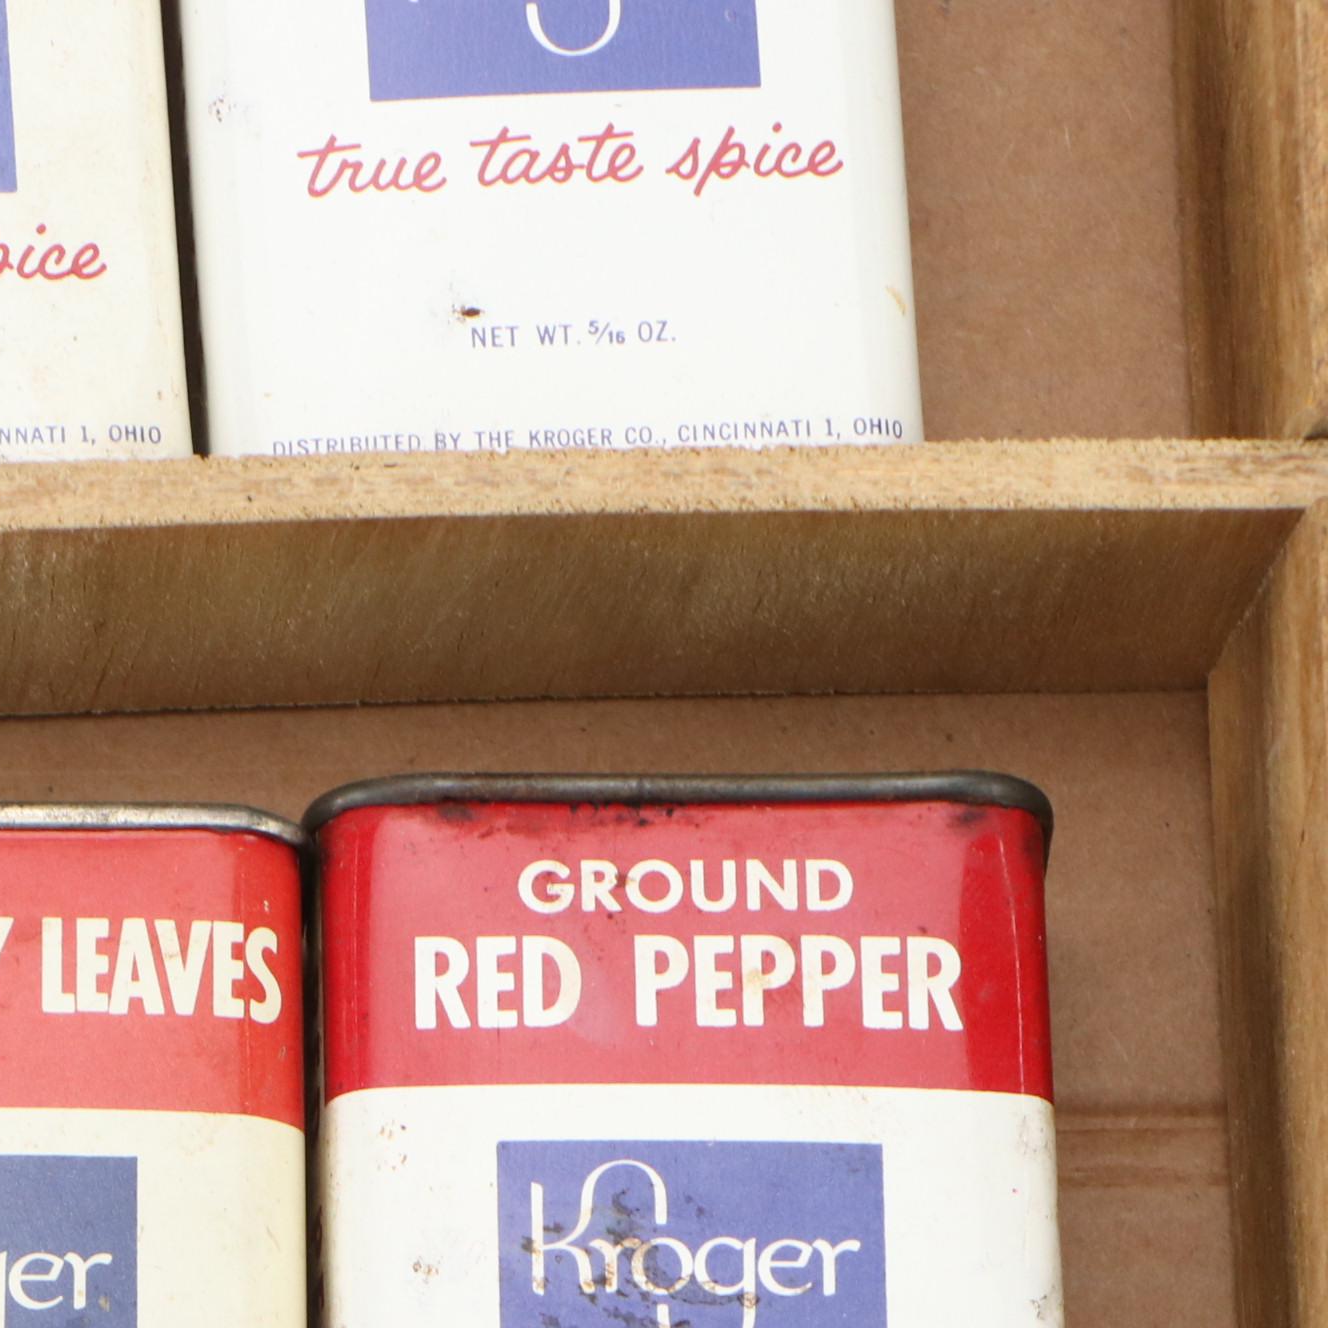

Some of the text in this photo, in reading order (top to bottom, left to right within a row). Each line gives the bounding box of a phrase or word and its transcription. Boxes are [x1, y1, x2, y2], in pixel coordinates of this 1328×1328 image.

[297, 122, 843, 199] true taste spice
[472, 326, 518, 348] NET
[536, 325, 580, 345] WT.
[638, 320, 675, 342] OZ.
[82, 426, 95, 447] 1,
[109, 426, 161, 444] OHIO
[434, 433, 460, 450] BY
[475, 431, 516, 449] THE
[528, 429, 612, 448] KROGER
[625, 428, 666, 448] CO.,
[678, 420, 811, 443] CINCINNATI
[826, 419, 840, 440] 1,
[854, 418, 902, 439] OHIO
[518, 860, 853, 913] GROUND
[42, 918, 281, 1023] LEAVES
[415, 935, 963, 1030] RED PEPPER
